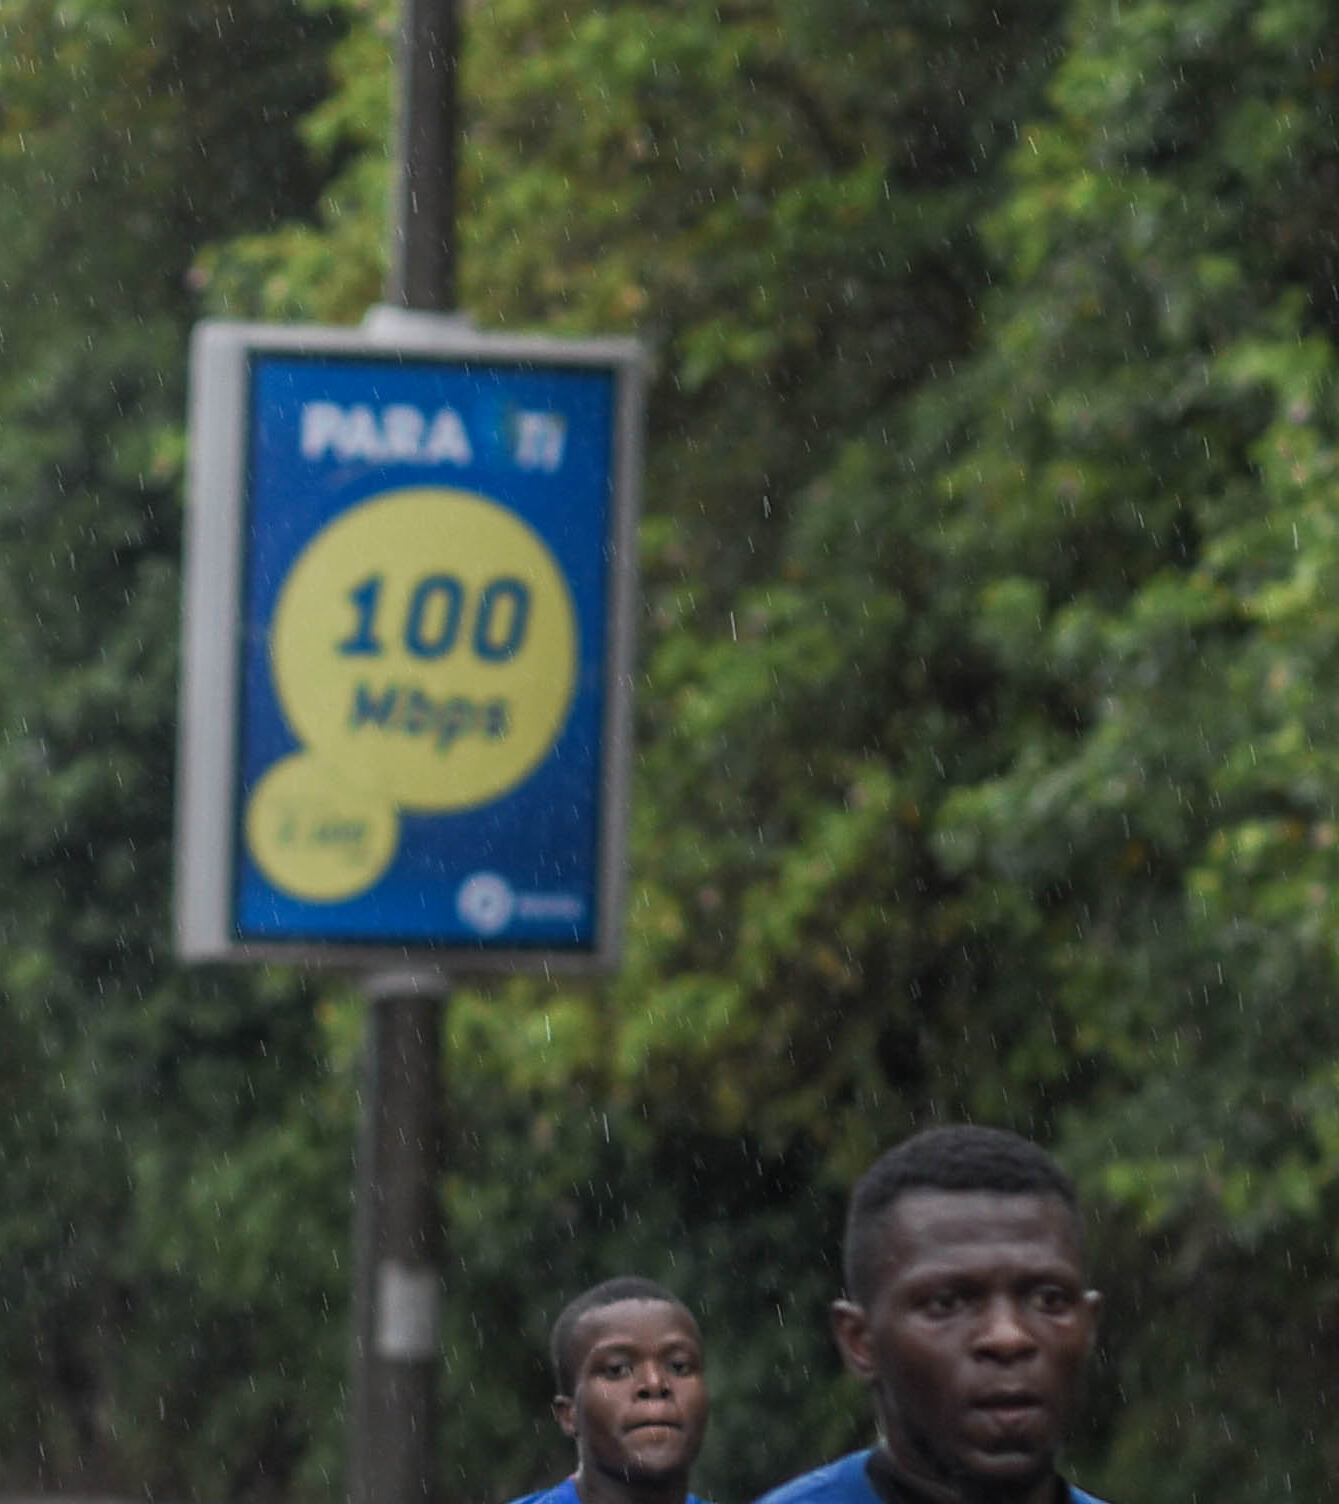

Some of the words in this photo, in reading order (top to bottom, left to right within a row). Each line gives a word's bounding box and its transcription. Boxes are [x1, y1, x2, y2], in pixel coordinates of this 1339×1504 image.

[301, 404, 473, 466] PARA
[337, 572, 531, 662] 100
[350, 682, 507, 756] Mbps
